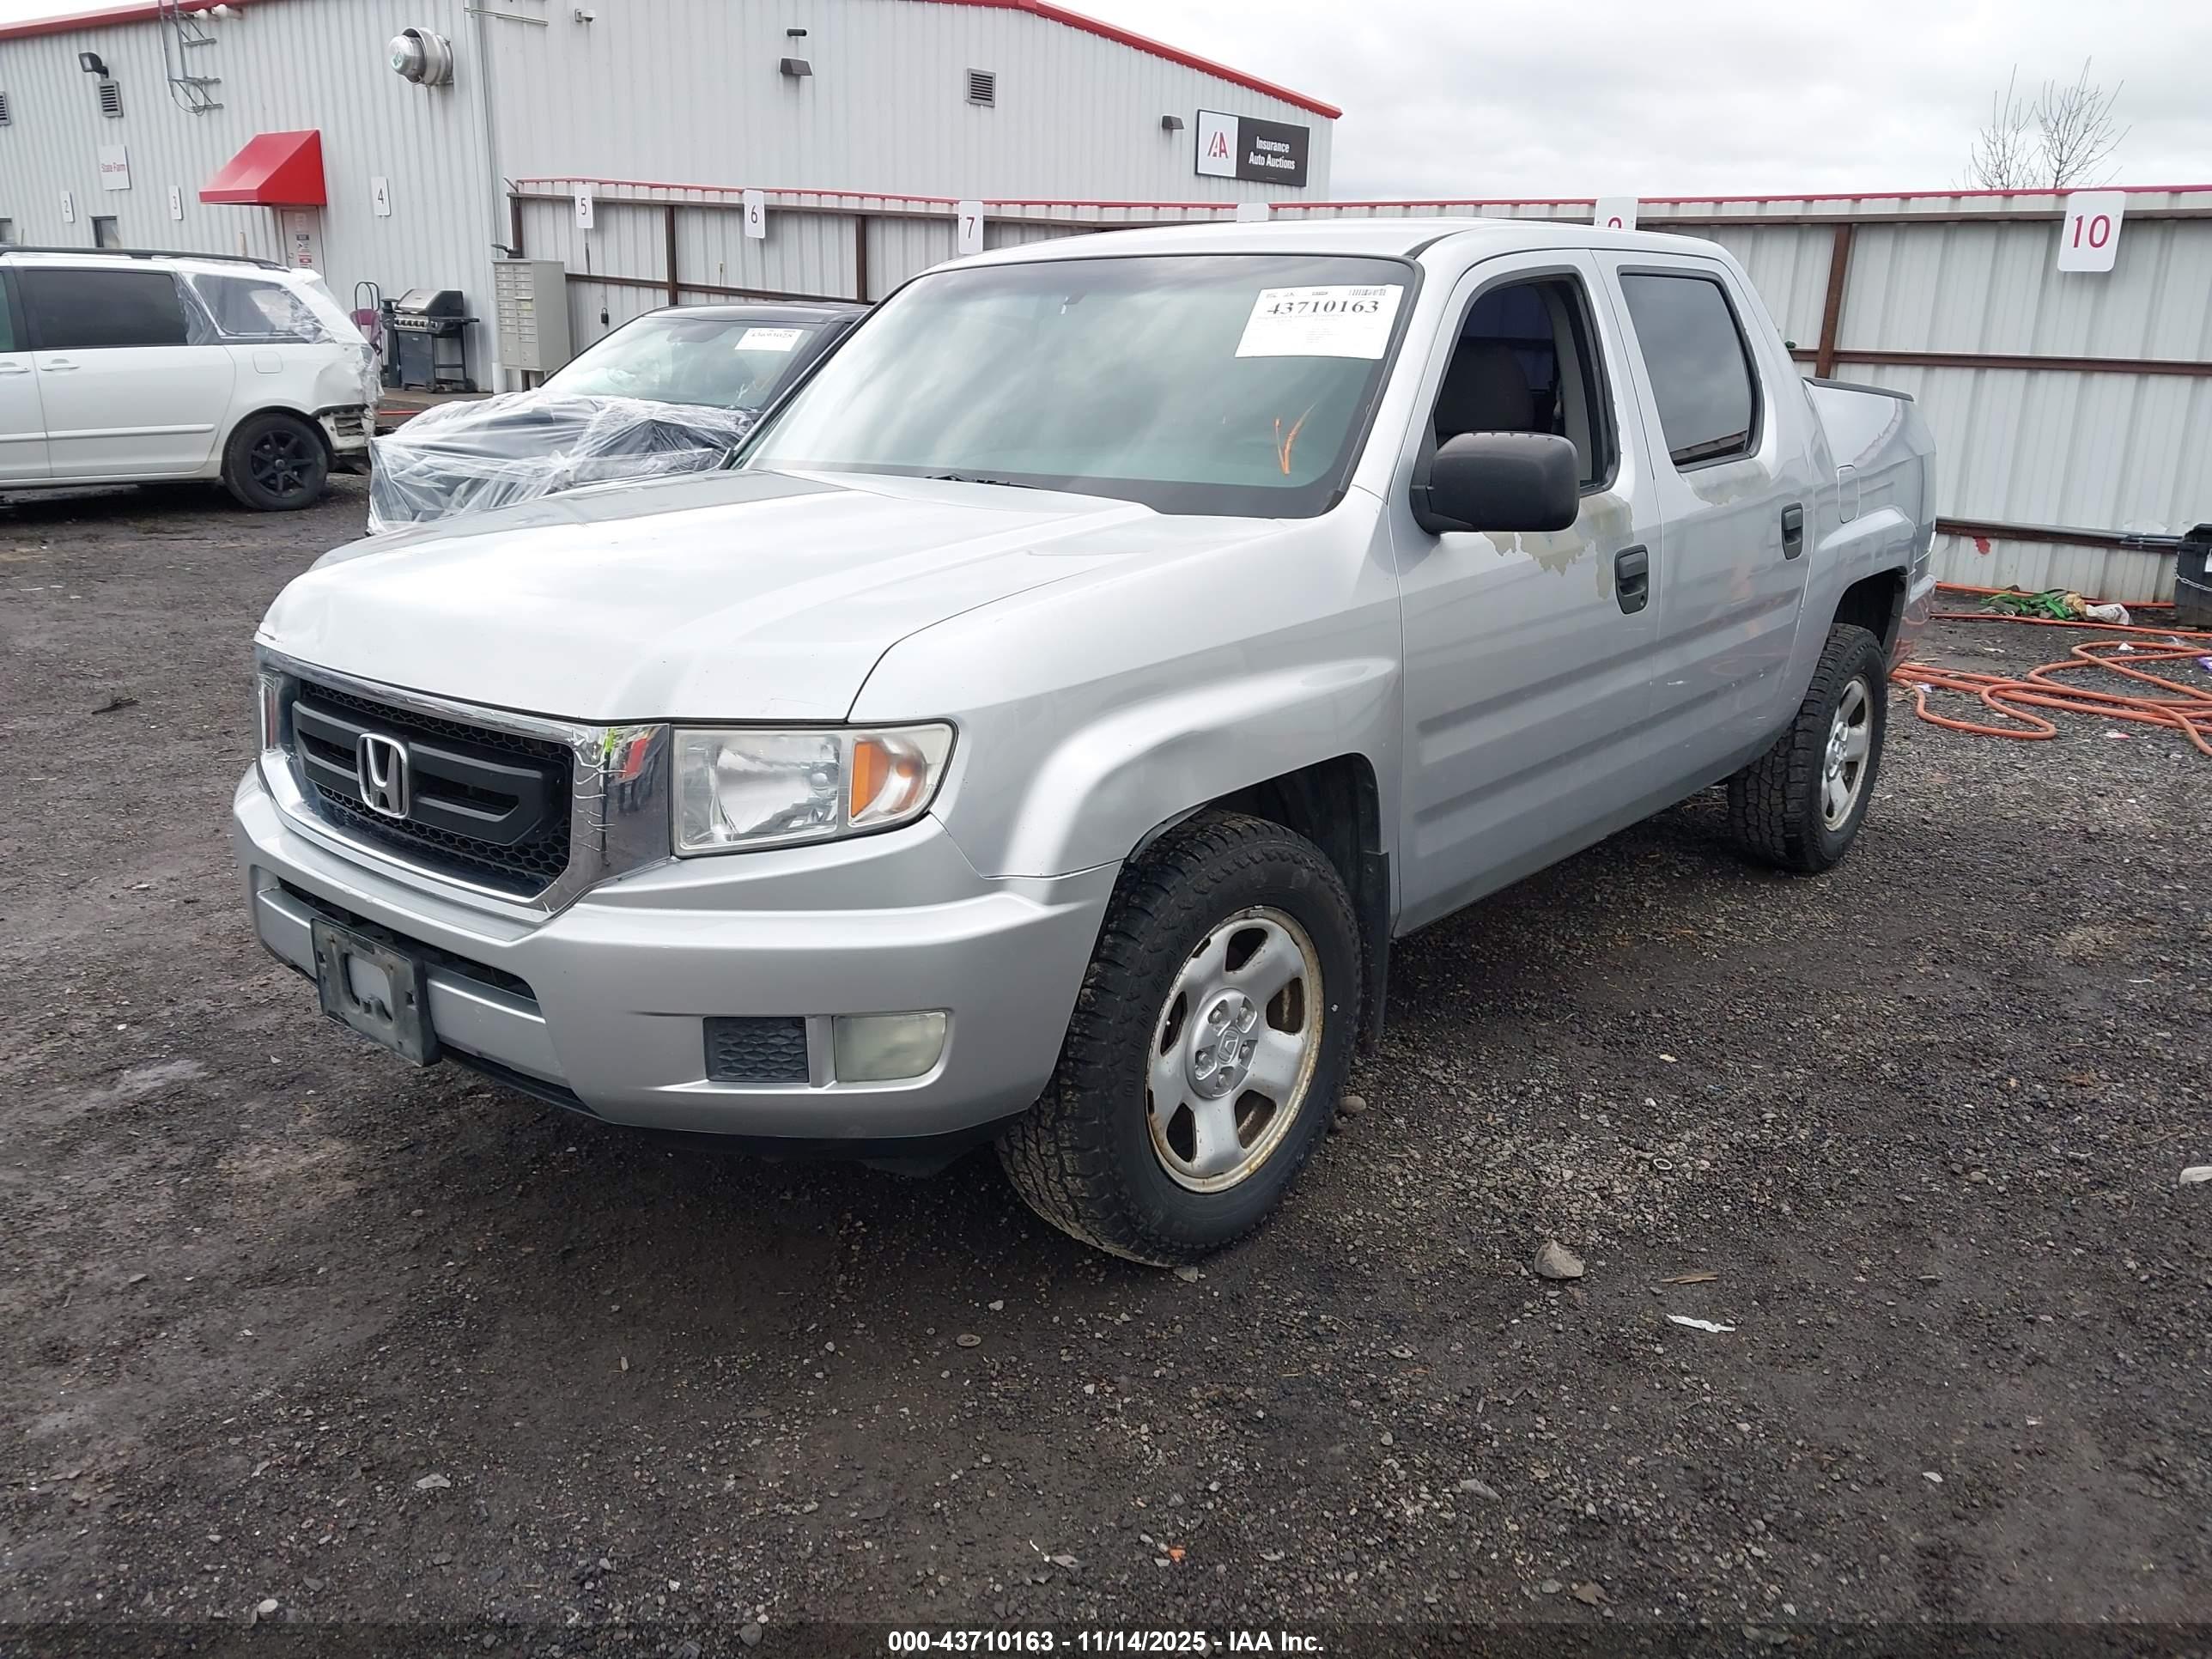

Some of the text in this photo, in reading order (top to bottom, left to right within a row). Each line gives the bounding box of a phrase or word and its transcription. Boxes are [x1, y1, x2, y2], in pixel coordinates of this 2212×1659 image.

[1256, 136, 1290, 153] Insurance
[1249, 151, 1296, 170] Auto Auctions
[173, 196, 178, 210] 3
[377, 188, 385, 204] 4
[64, 199, 70, 213] 2
[580, 198, 587, 216] 5
[750, 204, 758, 224] 6
[966, 216, 975, 239] 7
[2073, 215, 2111, 248] 10
[1267, 300, 1380, 315] 43710163
